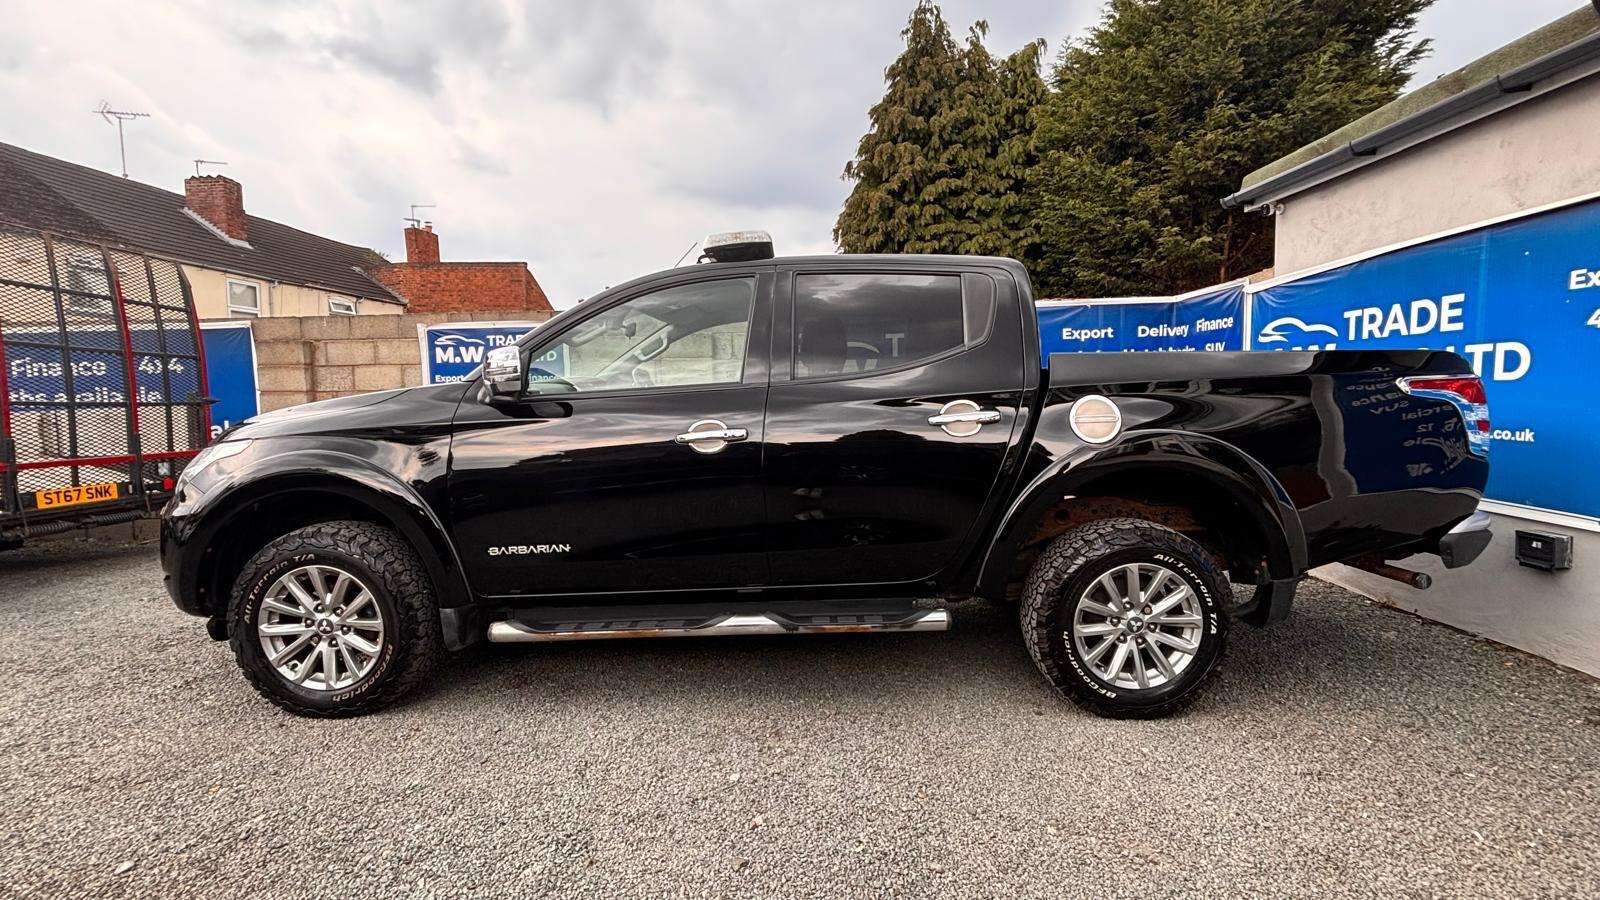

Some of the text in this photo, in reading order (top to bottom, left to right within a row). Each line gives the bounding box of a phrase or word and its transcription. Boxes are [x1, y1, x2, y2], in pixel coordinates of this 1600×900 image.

[1062, 315, 1234, 342] Export Delivery Finance
[1343, 293, 1466, 341] TRADE
[435, 346, 485, 363] M.W
[44, 485, 113, 505] ST67 SNK
[292, 552, 316, 563] T/A
[487, 544, 571, 556] BARBARIAN
[1153, 553, 1218, 635] All-Terrain T/A
[1063, 631, 1117, 699] BFGoodrich
